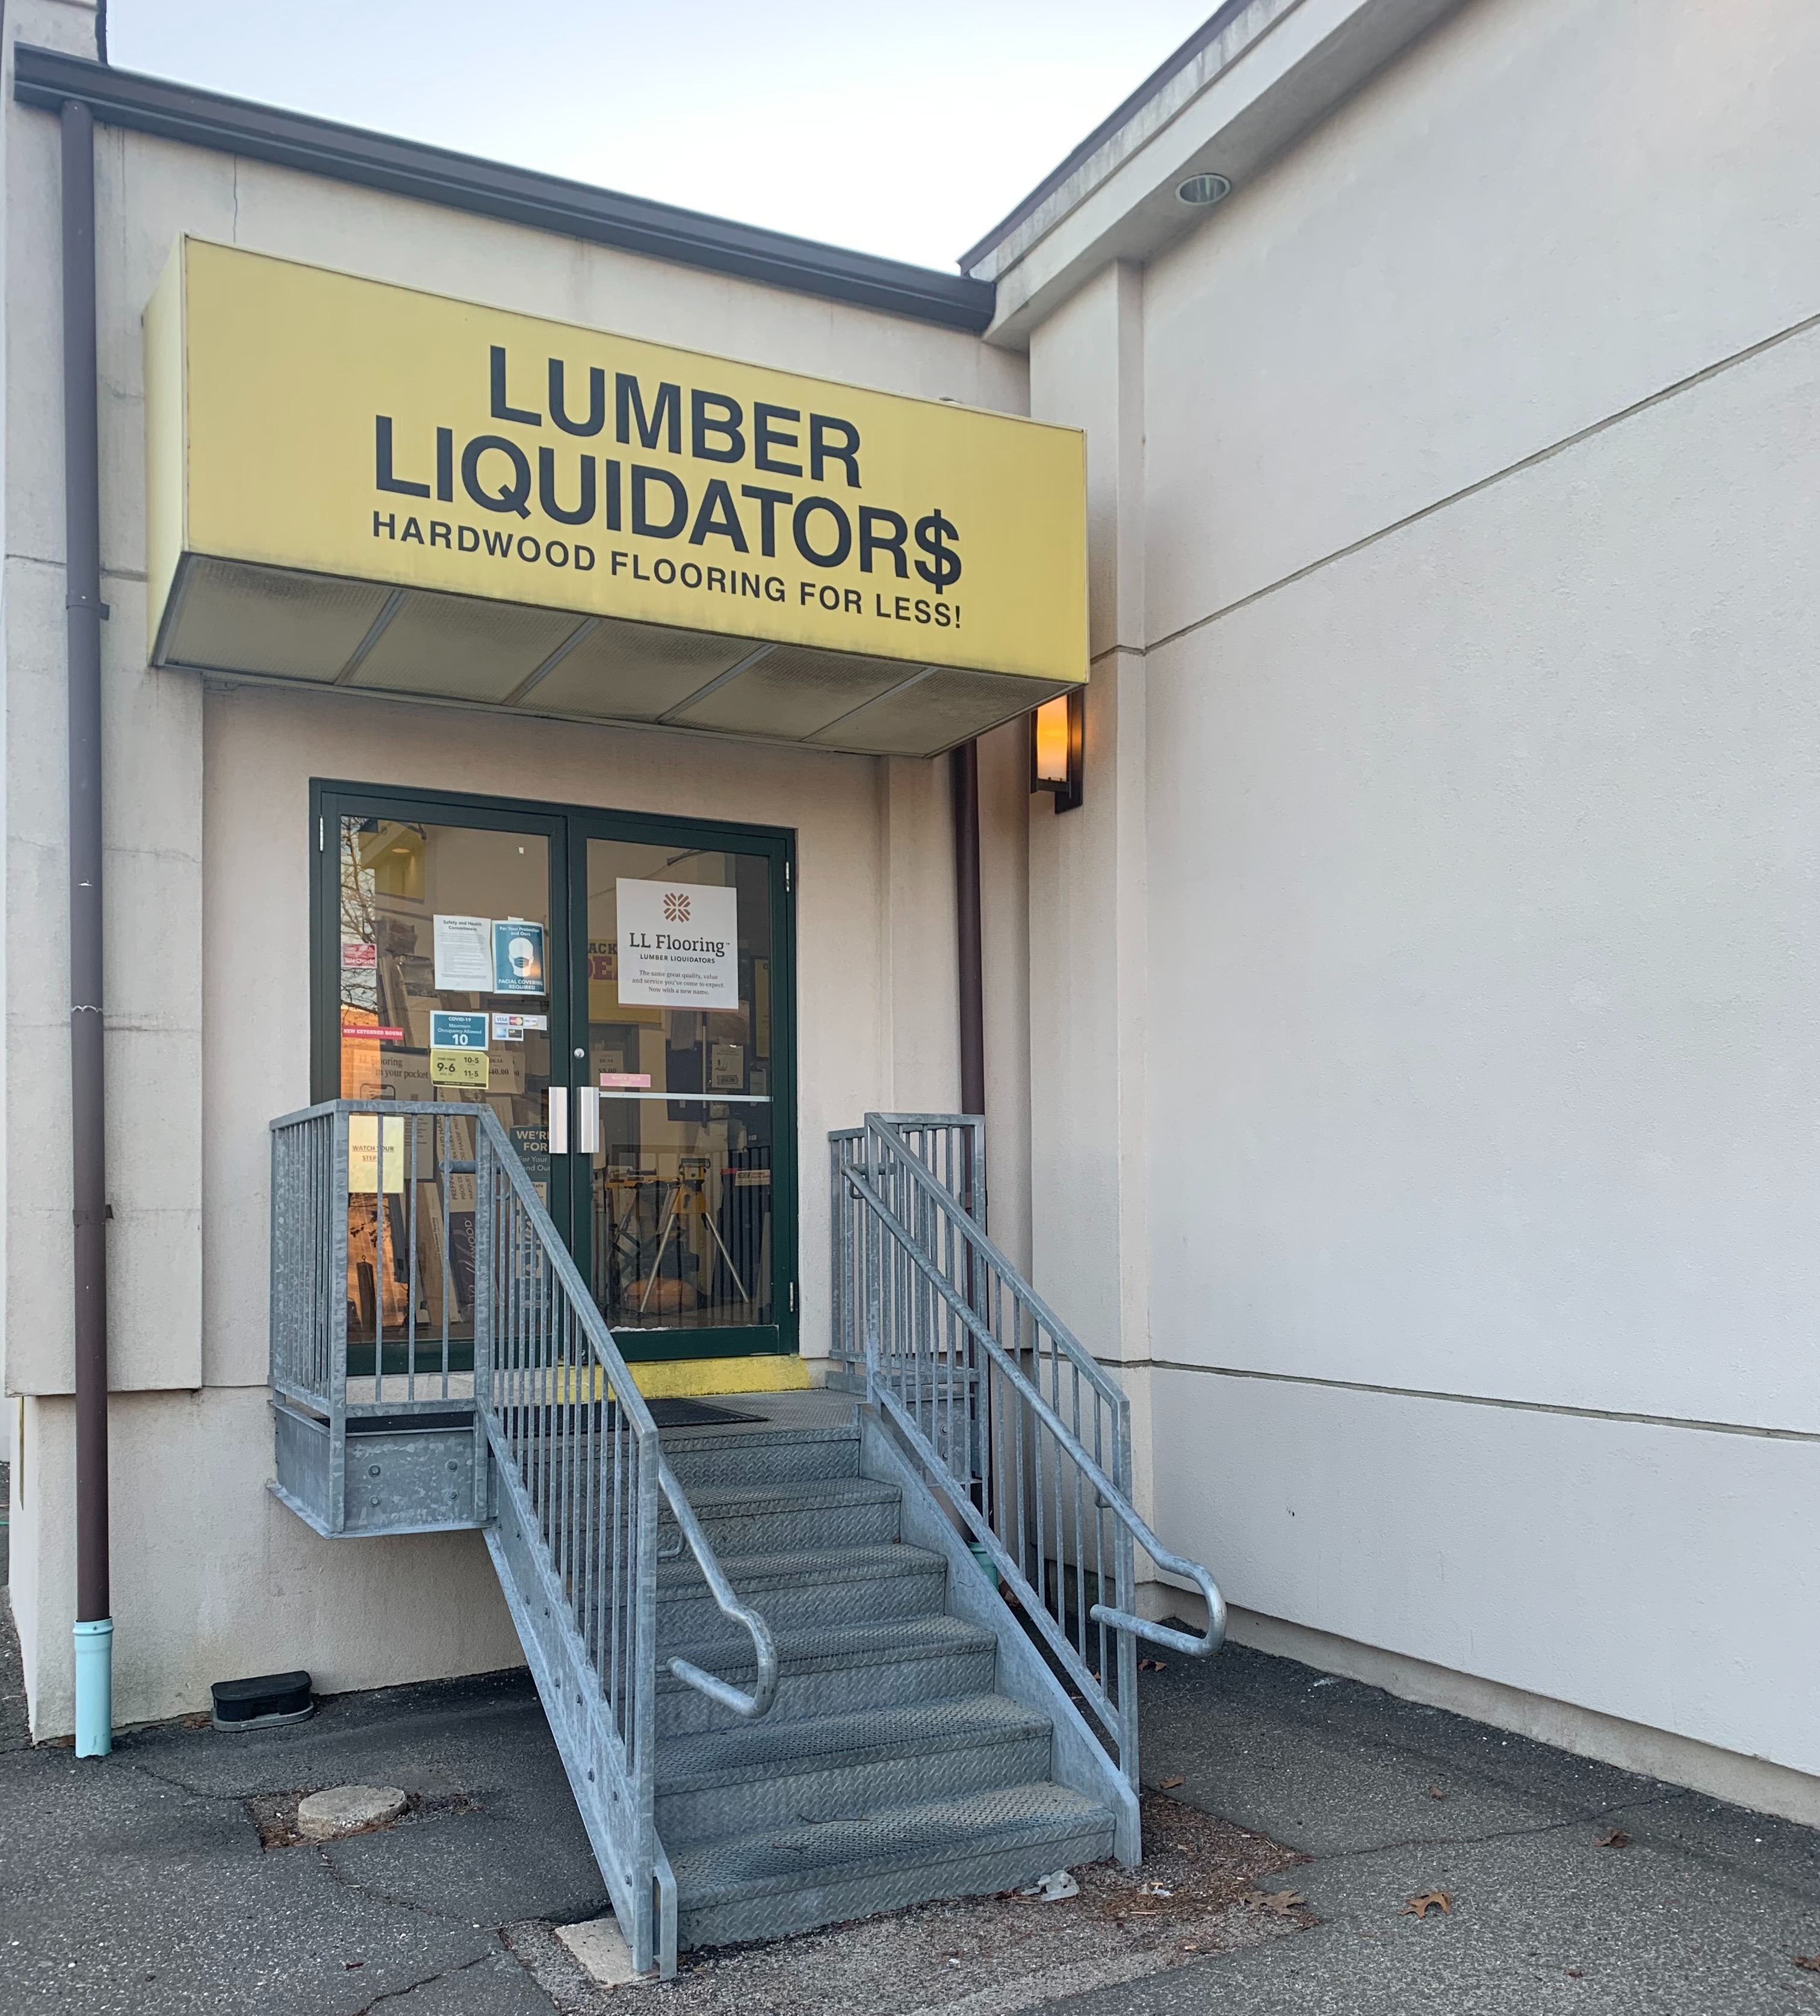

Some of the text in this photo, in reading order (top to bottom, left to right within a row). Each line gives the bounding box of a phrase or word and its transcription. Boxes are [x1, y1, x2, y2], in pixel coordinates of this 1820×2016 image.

[489, 344, 862, 489] LUMBER
[374, 414, 962, 595] LIQUIDATOR$
[372, 510, 962, 629] HARDWOOD FLOORING FOR LESS!
[629, 932, 651, 948] LL
[670, 956, 716, 964] LIQUIDATORS
[452, 1034, 468, 1045] 10
[370, 1056, 403, 1068] Flooring
[436, 1062, 456, 1073] 9-6
[385, 1069, 403, 1078] your
[404, 1069, 429, 1079] pocket
[516, 1131, 549, 1140] WE'R
[523, 1142, 548, 1151] FOR
[449, 1173, 457, 1200] PREFINI
